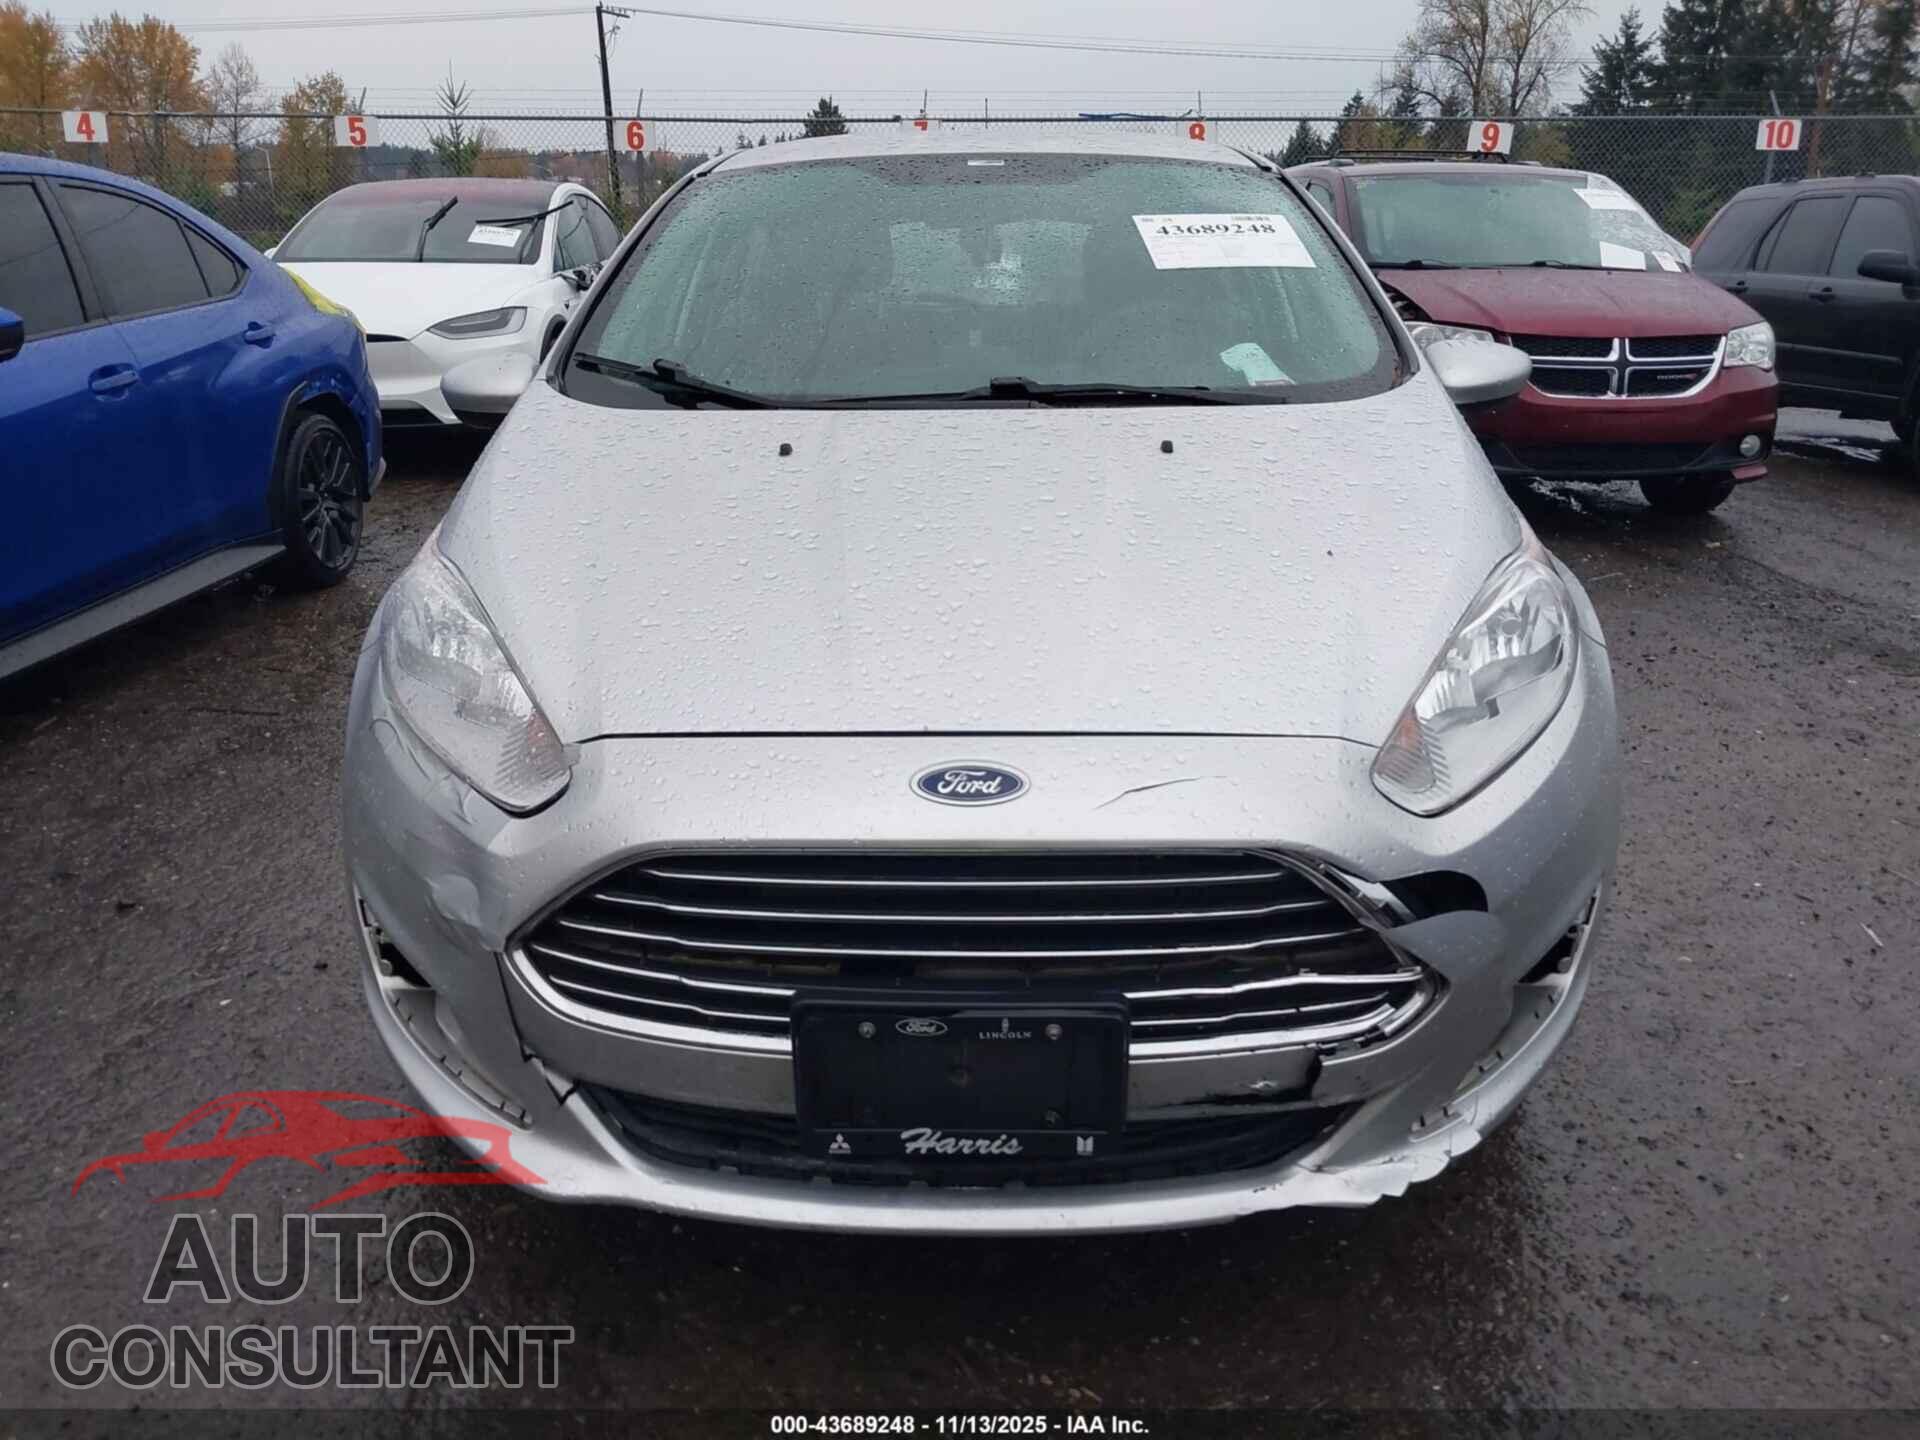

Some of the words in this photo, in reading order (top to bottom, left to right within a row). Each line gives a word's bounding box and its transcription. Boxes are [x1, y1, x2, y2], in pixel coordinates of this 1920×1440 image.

[77, 112, 95, 140] 4
[347, 116, 366, 146] 5
[626, 121, 645, 150] 6
[1481, 122, 1500, 152] 9
[1766, 120, 1794, 150] 10
[1155, 223, 1276, 236] 43689248
[936, 769, 1002, 794] Ford
[978, 1030, 1032, 1040] LINCOLN
[900, 1127, 1023, 1155] Harris
